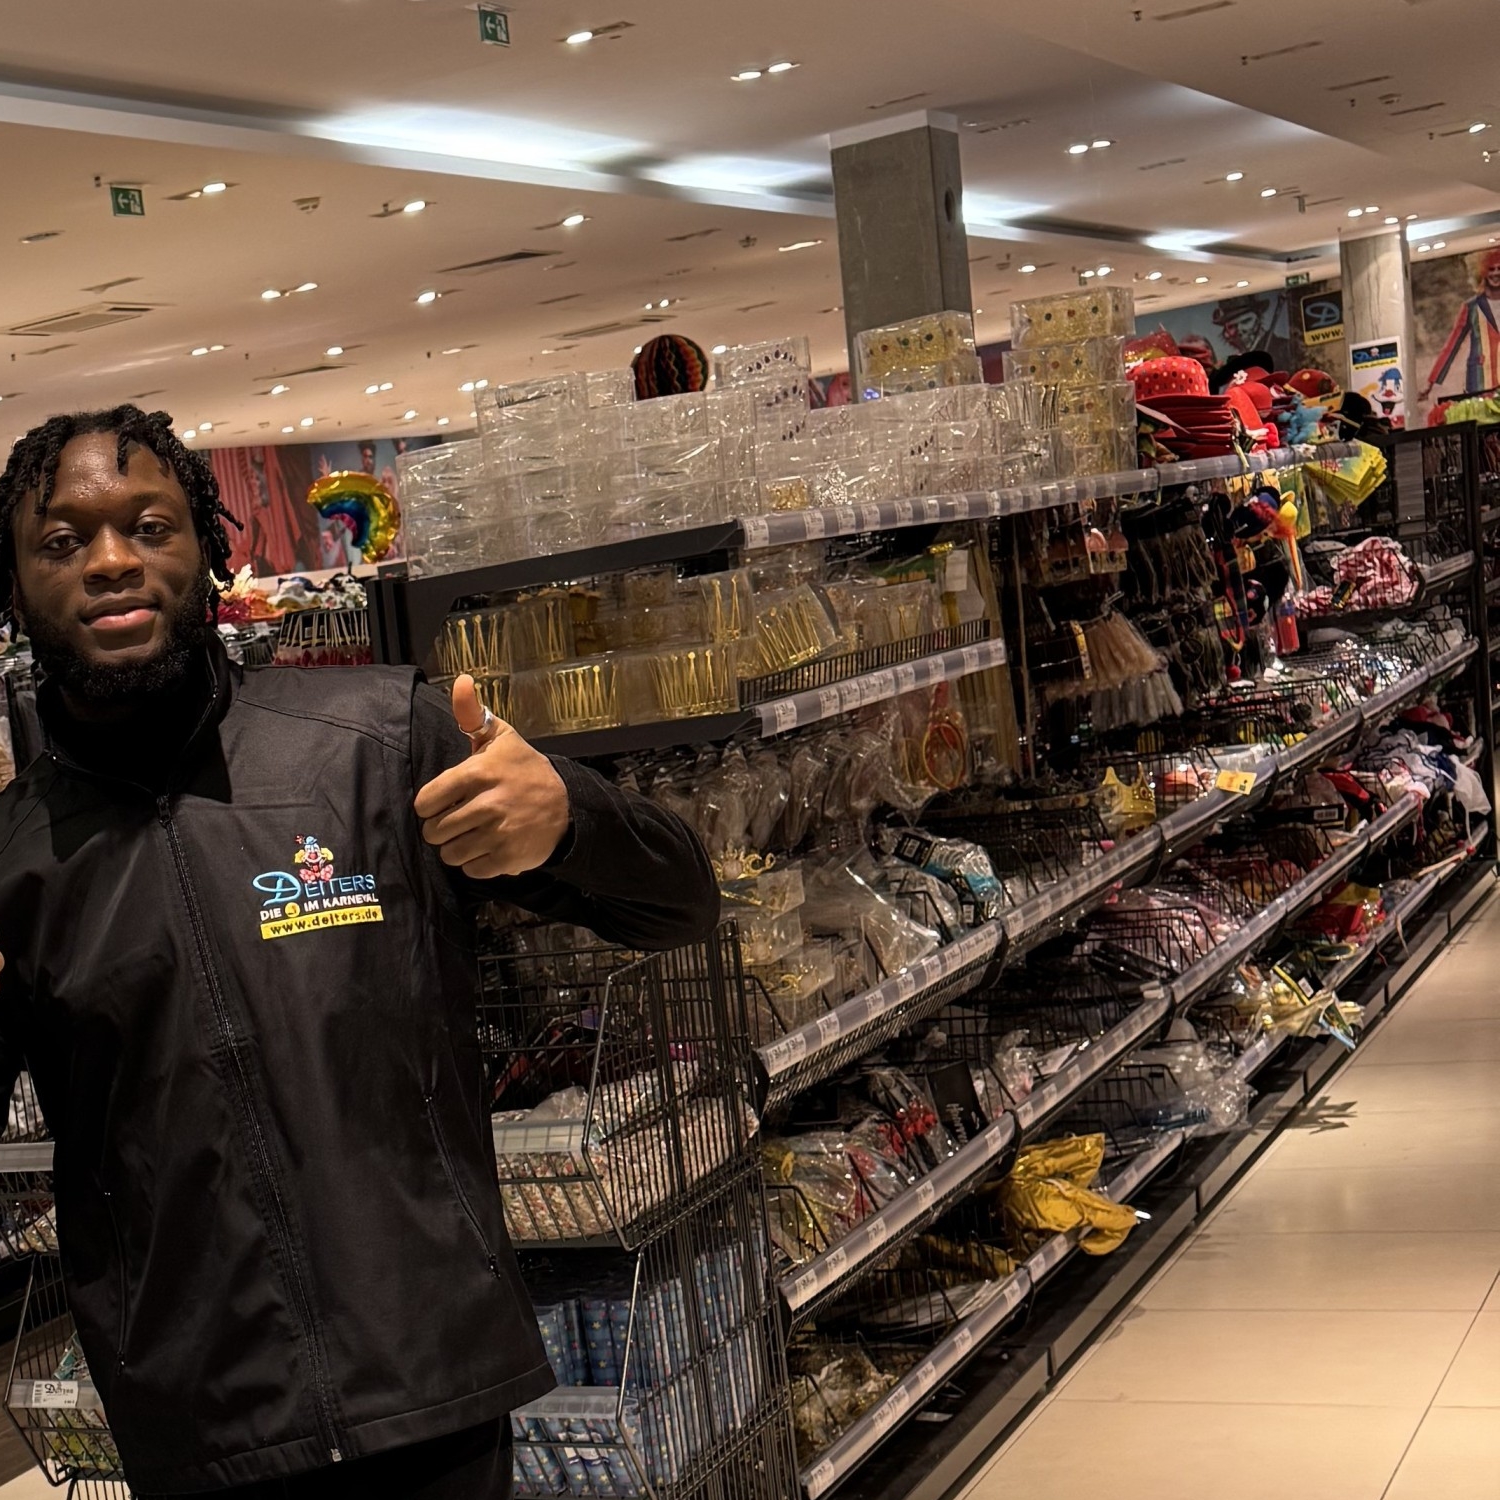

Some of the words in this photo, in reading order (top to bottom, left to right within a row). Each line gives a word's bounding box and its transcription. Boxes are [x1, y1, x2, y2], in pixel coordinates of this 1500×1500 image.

[252, 871, 376, 907] DEITERS
[260, 908, 282, 921] DIE
[304, 902, 319, 913] IM
[322, 893, 379, 909] KARNEVAL
[270, 908, 378, 935] www.deiters.de
